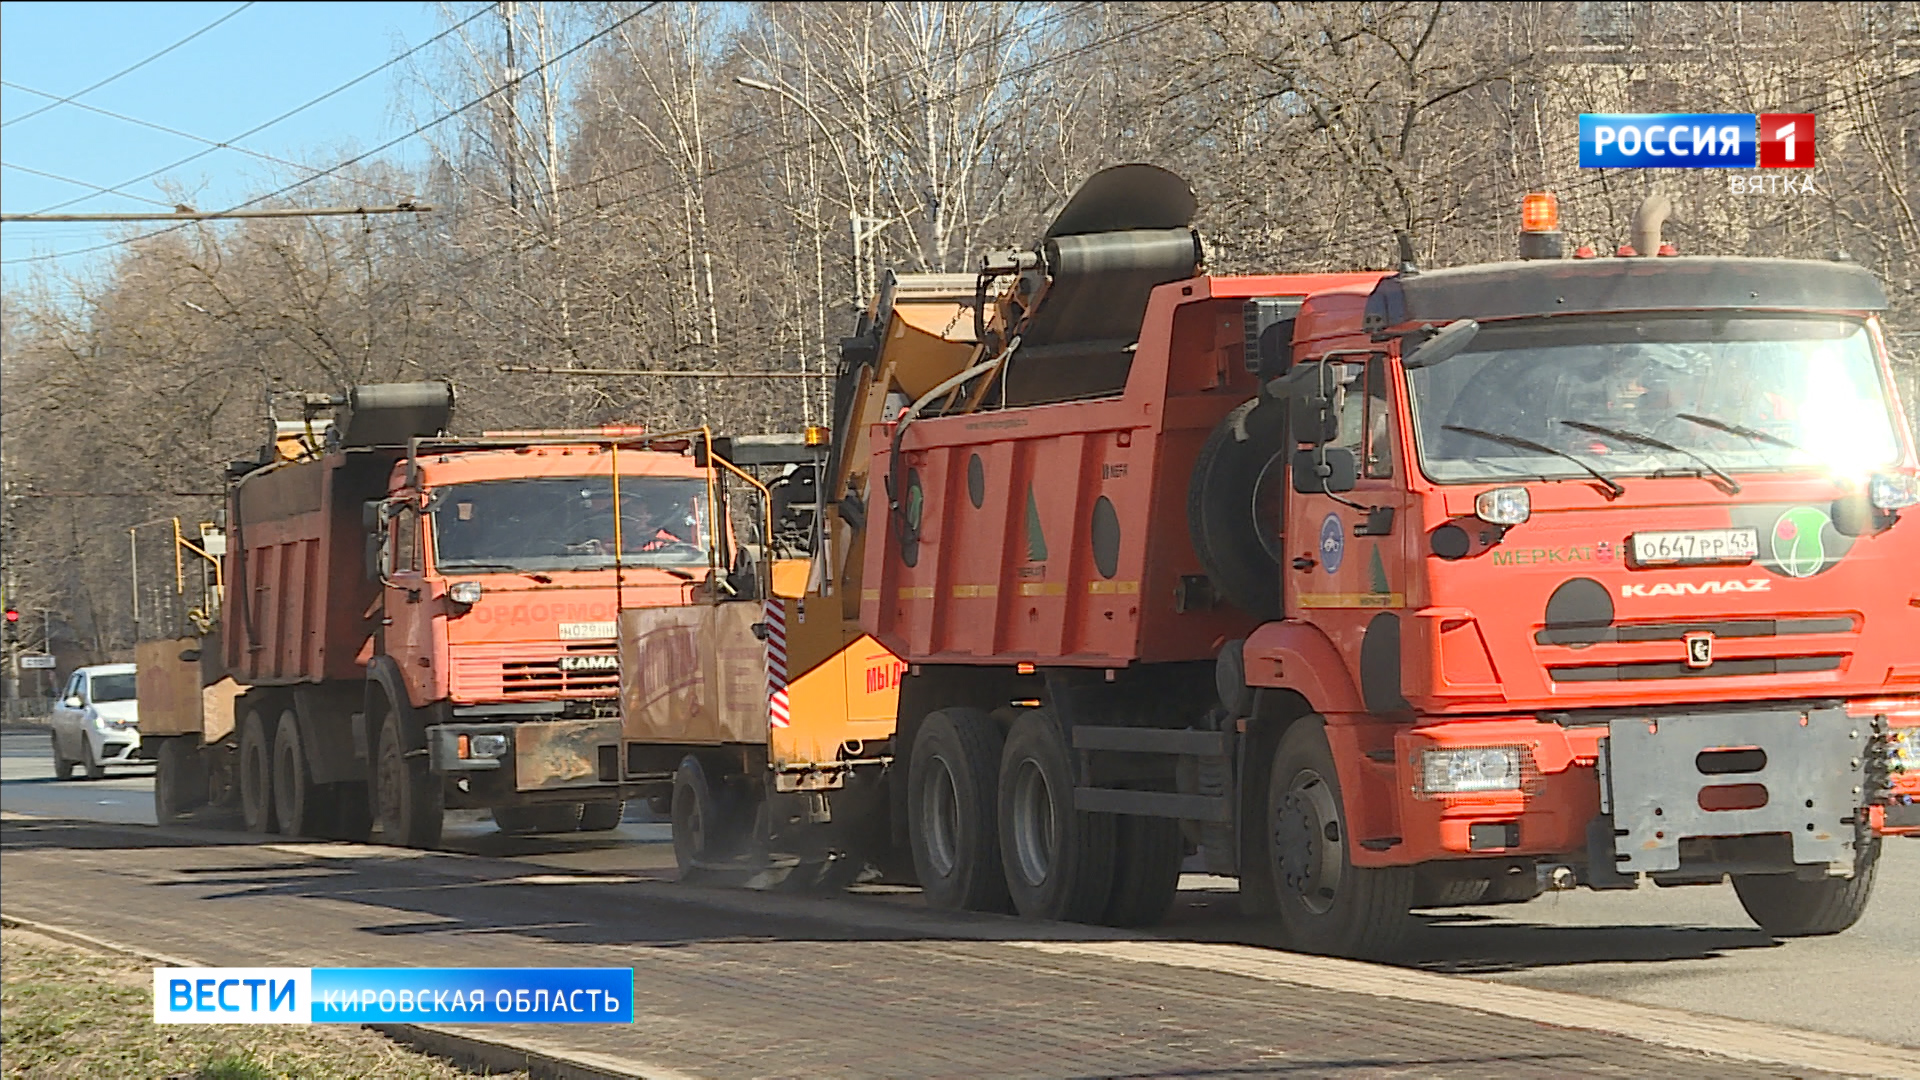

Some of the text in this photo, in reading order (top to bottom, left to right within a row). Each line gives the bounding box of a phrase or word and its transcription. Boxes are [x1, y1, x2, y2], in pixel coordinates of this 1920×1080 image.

[1621, 578, 1772, 598] KAMAZ
[561, 655, 619, 670] KAMA
[866, 663, 889, 694] МЫ
